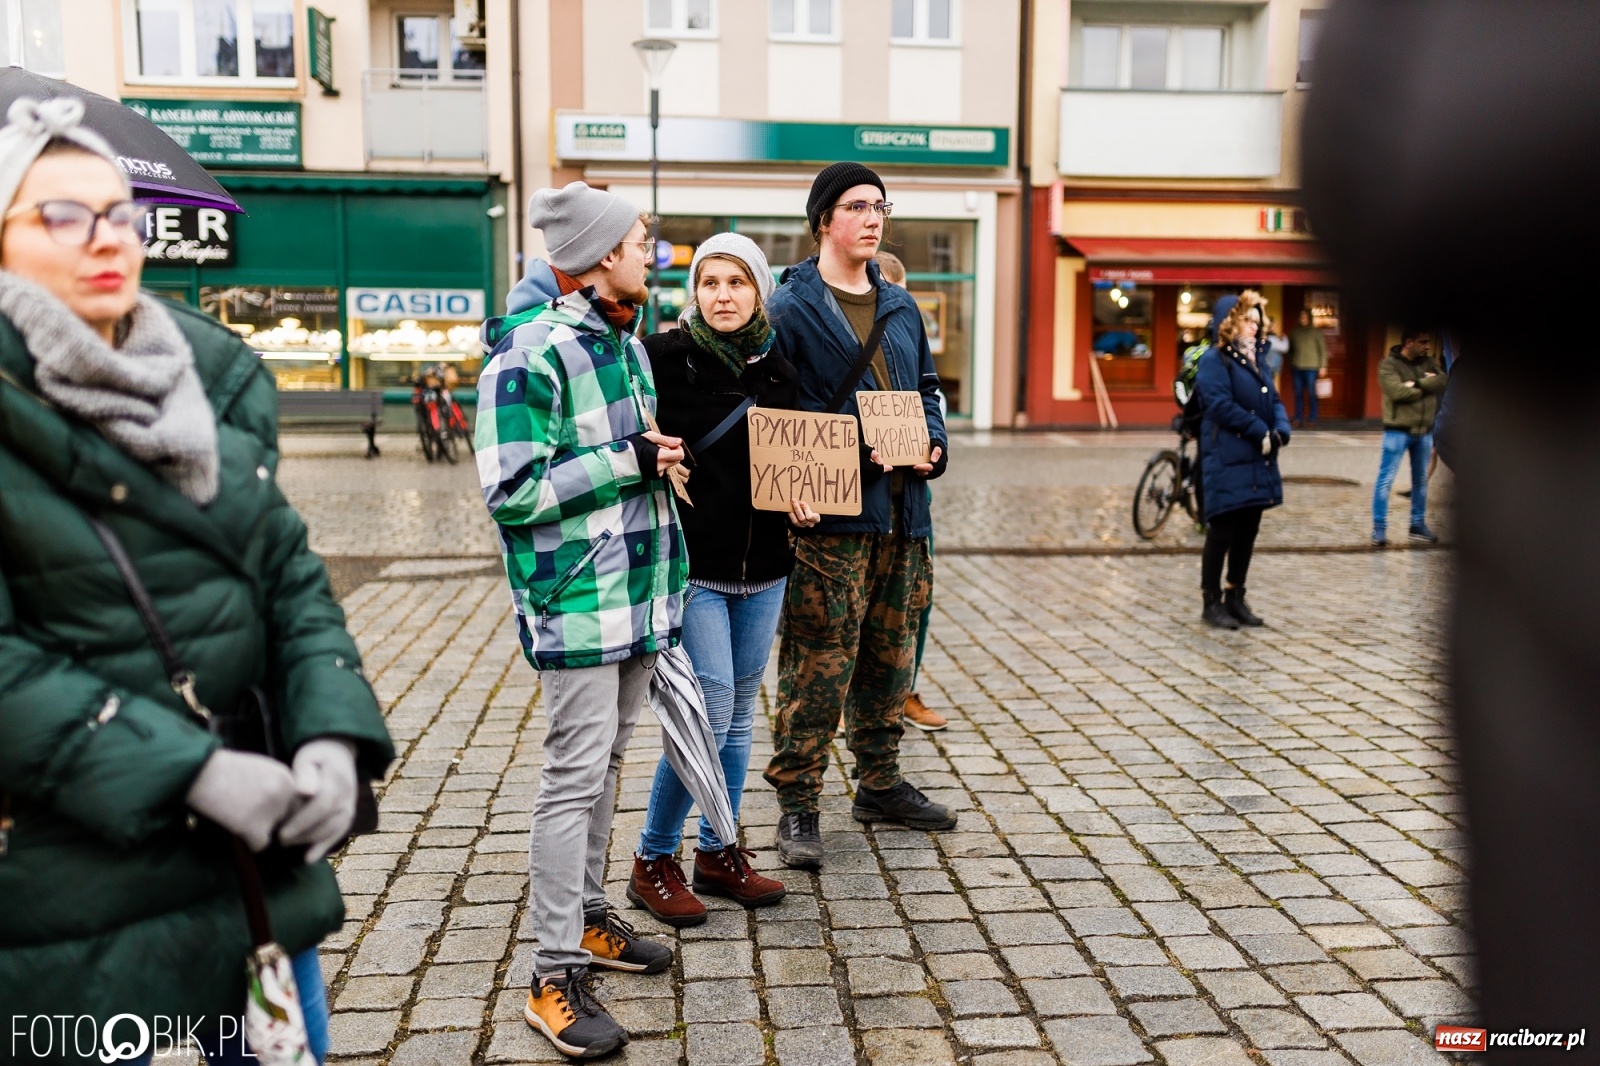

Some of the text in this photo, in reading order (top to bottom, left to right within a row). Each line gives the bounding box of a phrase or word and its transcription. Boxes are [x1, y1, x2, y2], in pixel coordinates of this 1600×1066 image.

[356, 293, 469, 314] CASIO
[859, 394, 924, 418] ВСЕ БУДЕ
[750, 412, 856, 449] РУКИ ХЕТЬ
[865, 424, 930, 458] УКРАЇНА
[790, 449, 815, 463] ВІД
[753, 462, 858, 504] УКРАЇНИ
